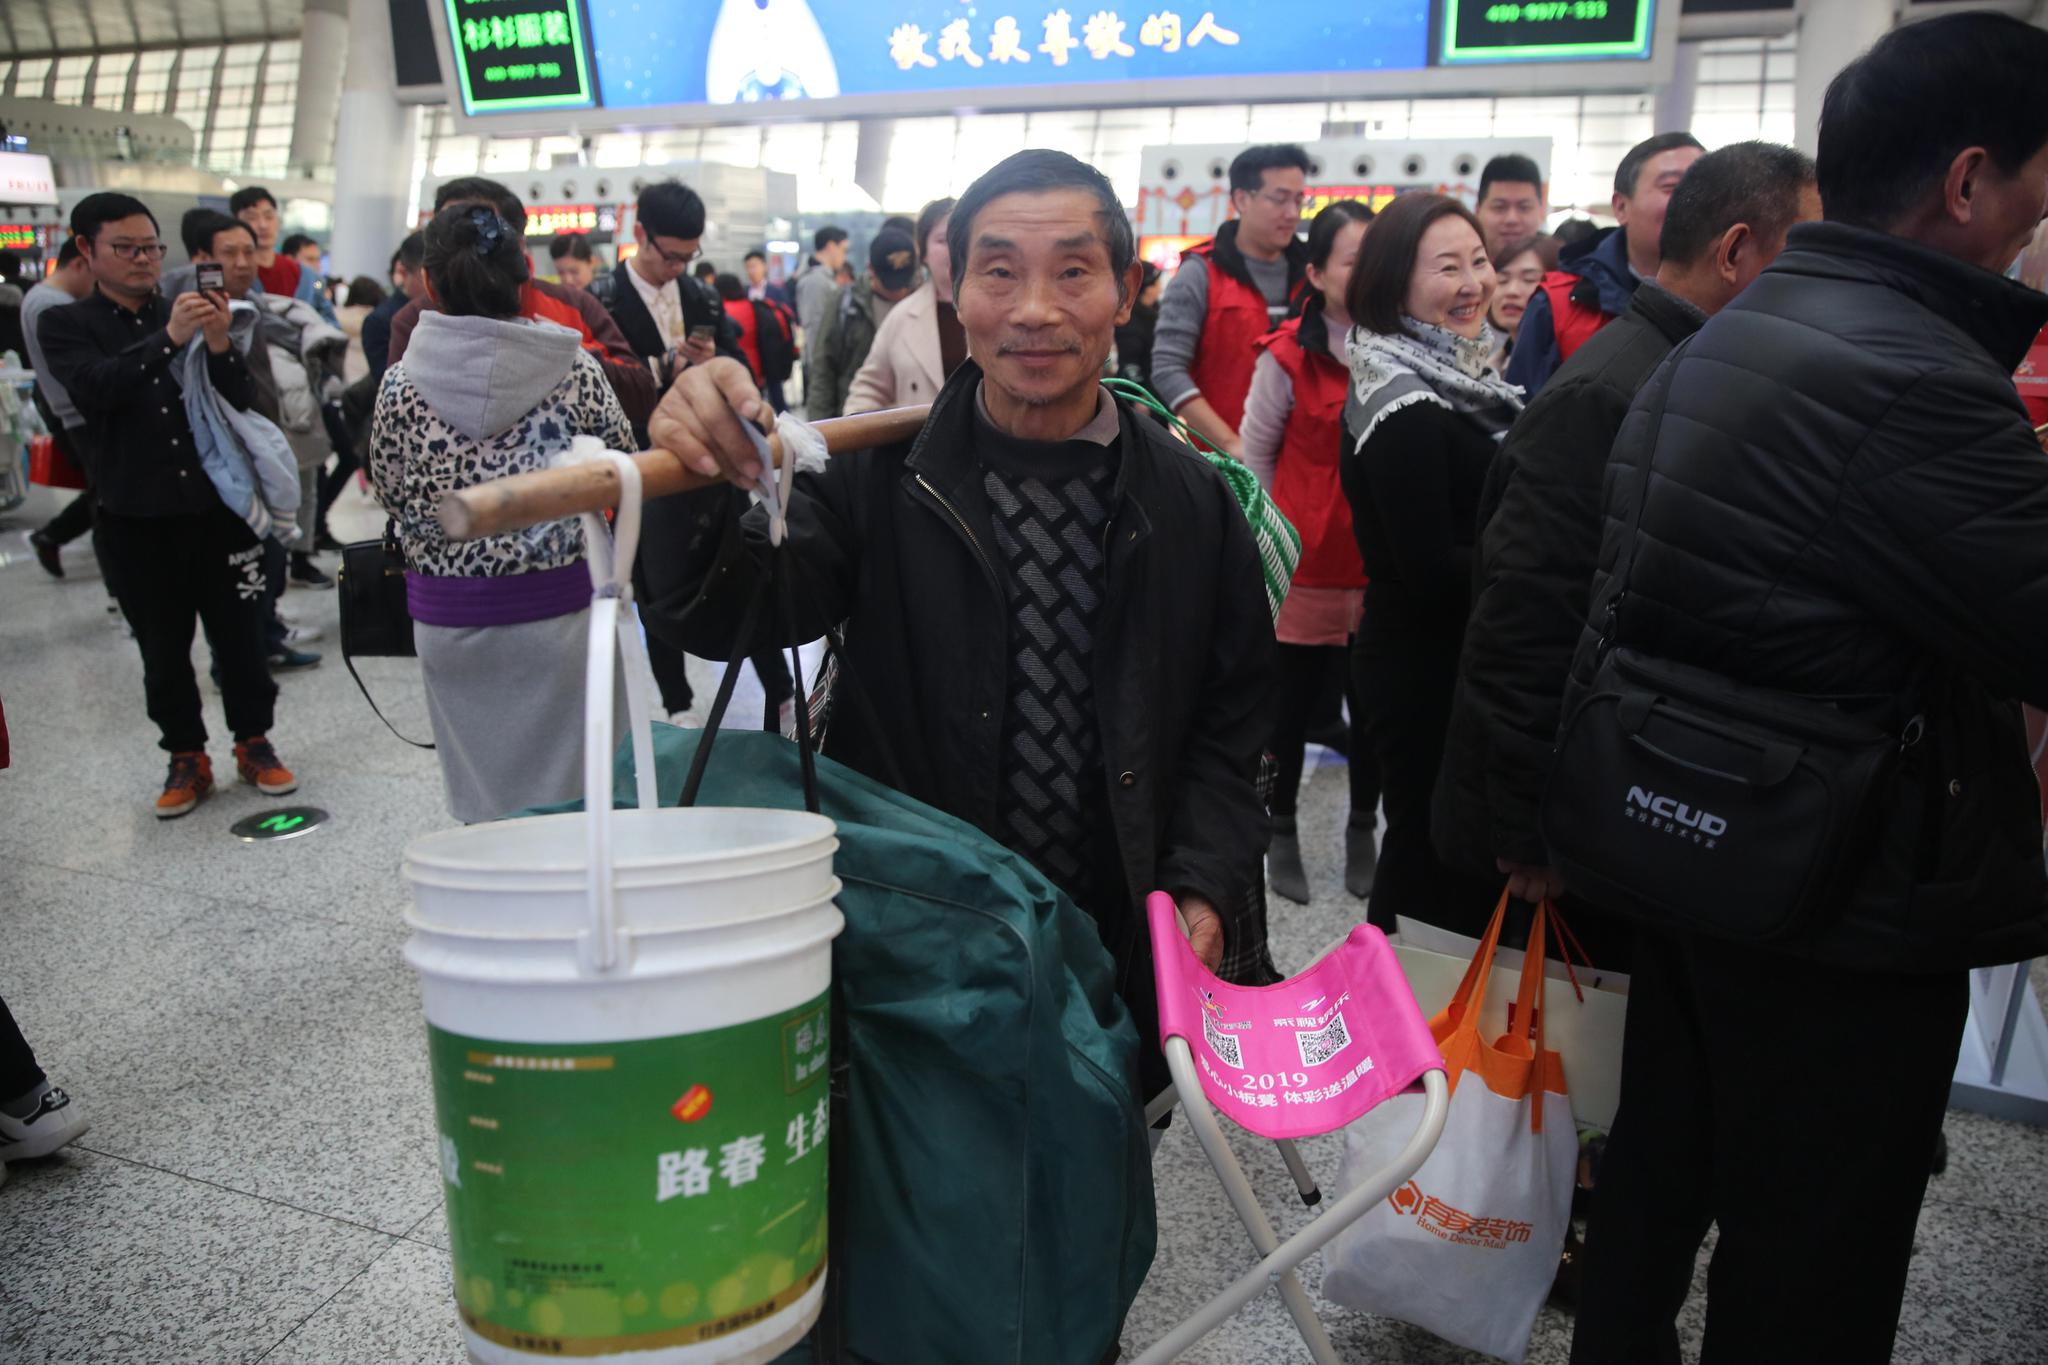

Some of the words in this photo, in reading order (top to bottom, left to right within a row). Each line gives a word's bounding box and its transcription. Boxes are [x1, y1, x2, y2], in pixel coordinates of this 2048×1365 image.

[888, 9, 1240, 70] 敬我最尊敬的人
[1626, 785, 1727, 836] NCUD
[1241, 1071, 1309, 1090] 2019
[1283, 1056, 1375, 1104] 体彩送温暖
[656, 1133, 767, 1203] 路春
[1416, 1215, 1448, 1240] Home
[1449, 1232, 1482, 1249] Decor
